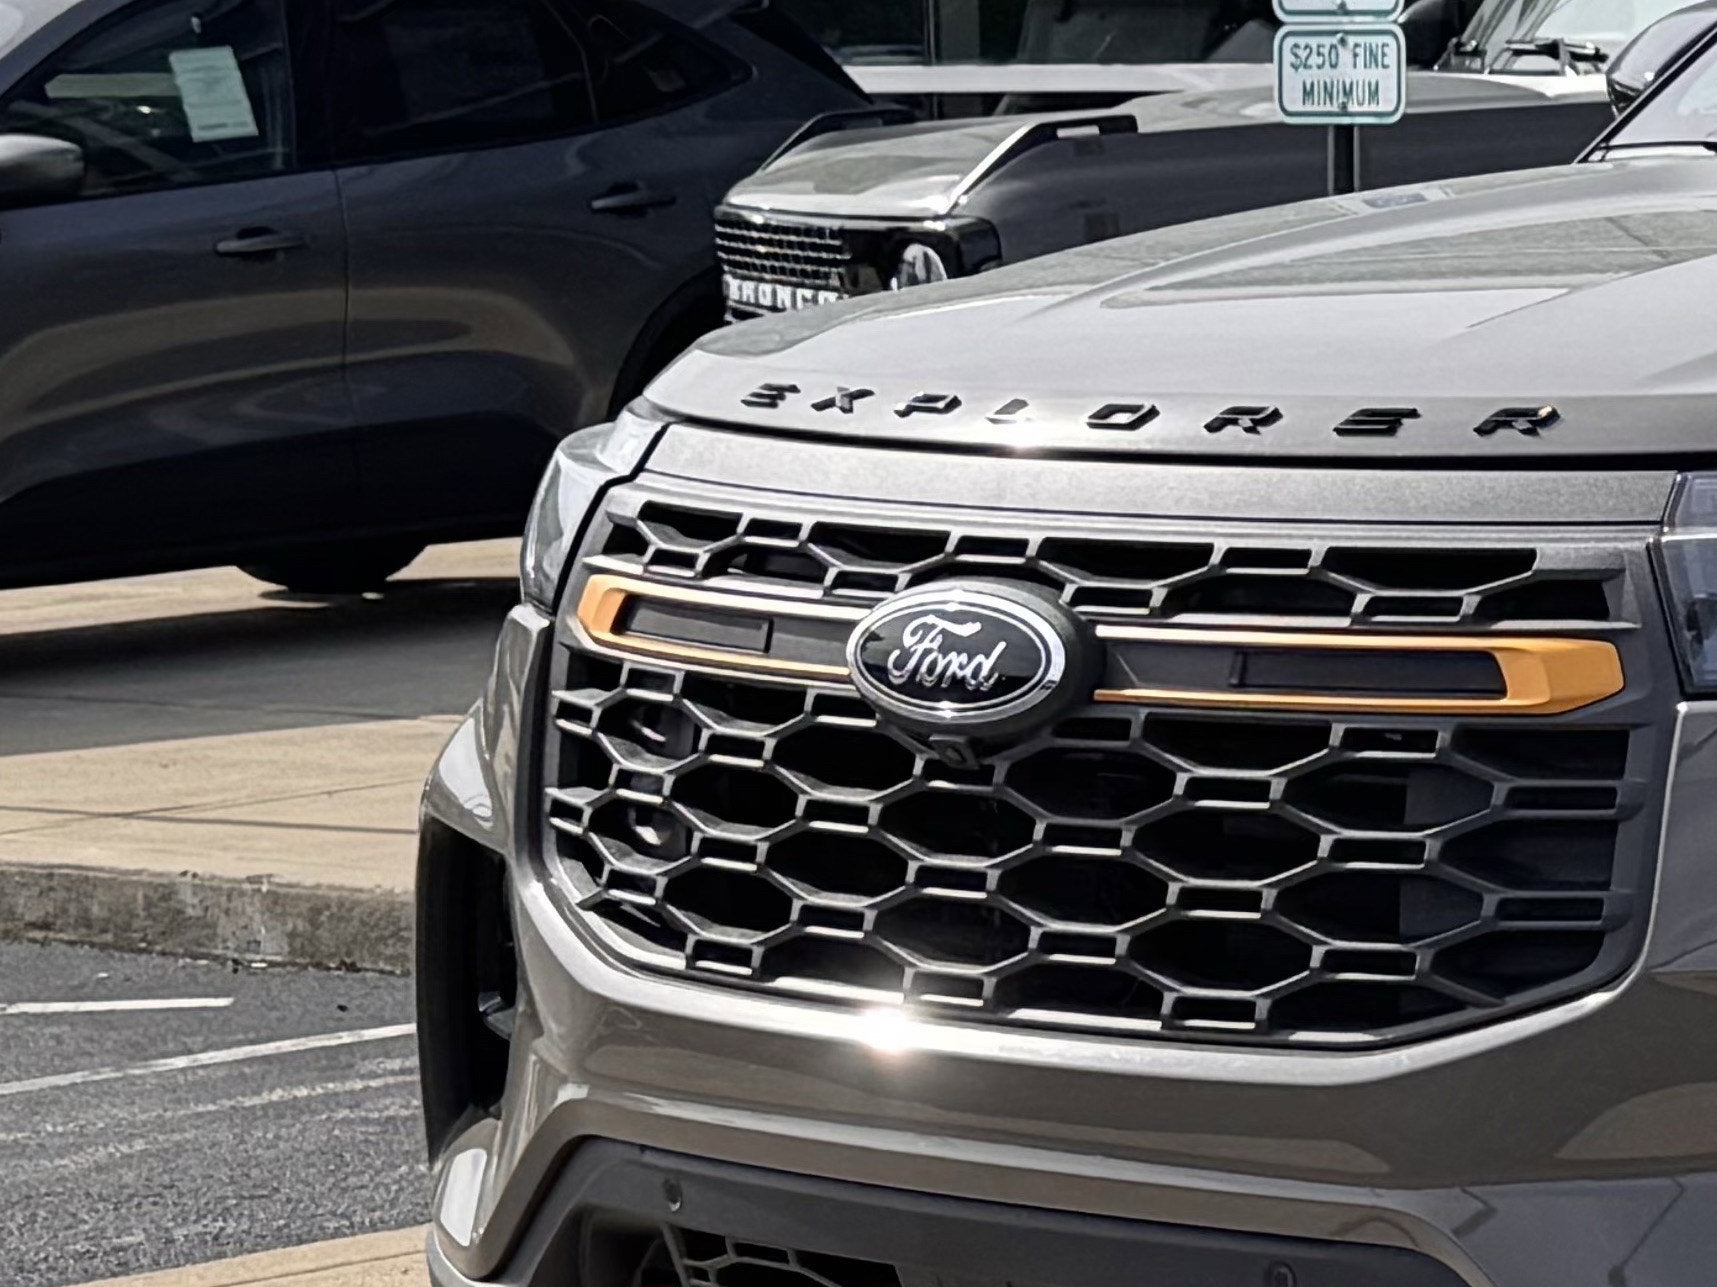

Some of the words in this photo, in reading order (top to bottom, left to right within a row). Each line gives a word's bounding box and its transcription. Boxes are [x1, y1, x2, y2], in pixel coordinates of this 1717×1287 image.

[1289, 42, 1339, 72] $250
[1352, 42, 1390, 70] FINE
[1302, 79, 1380, 108] MINIMUM
[740, 382, 1564, 438] EXPLORER
[886, 613, 1008, 694] Ford
